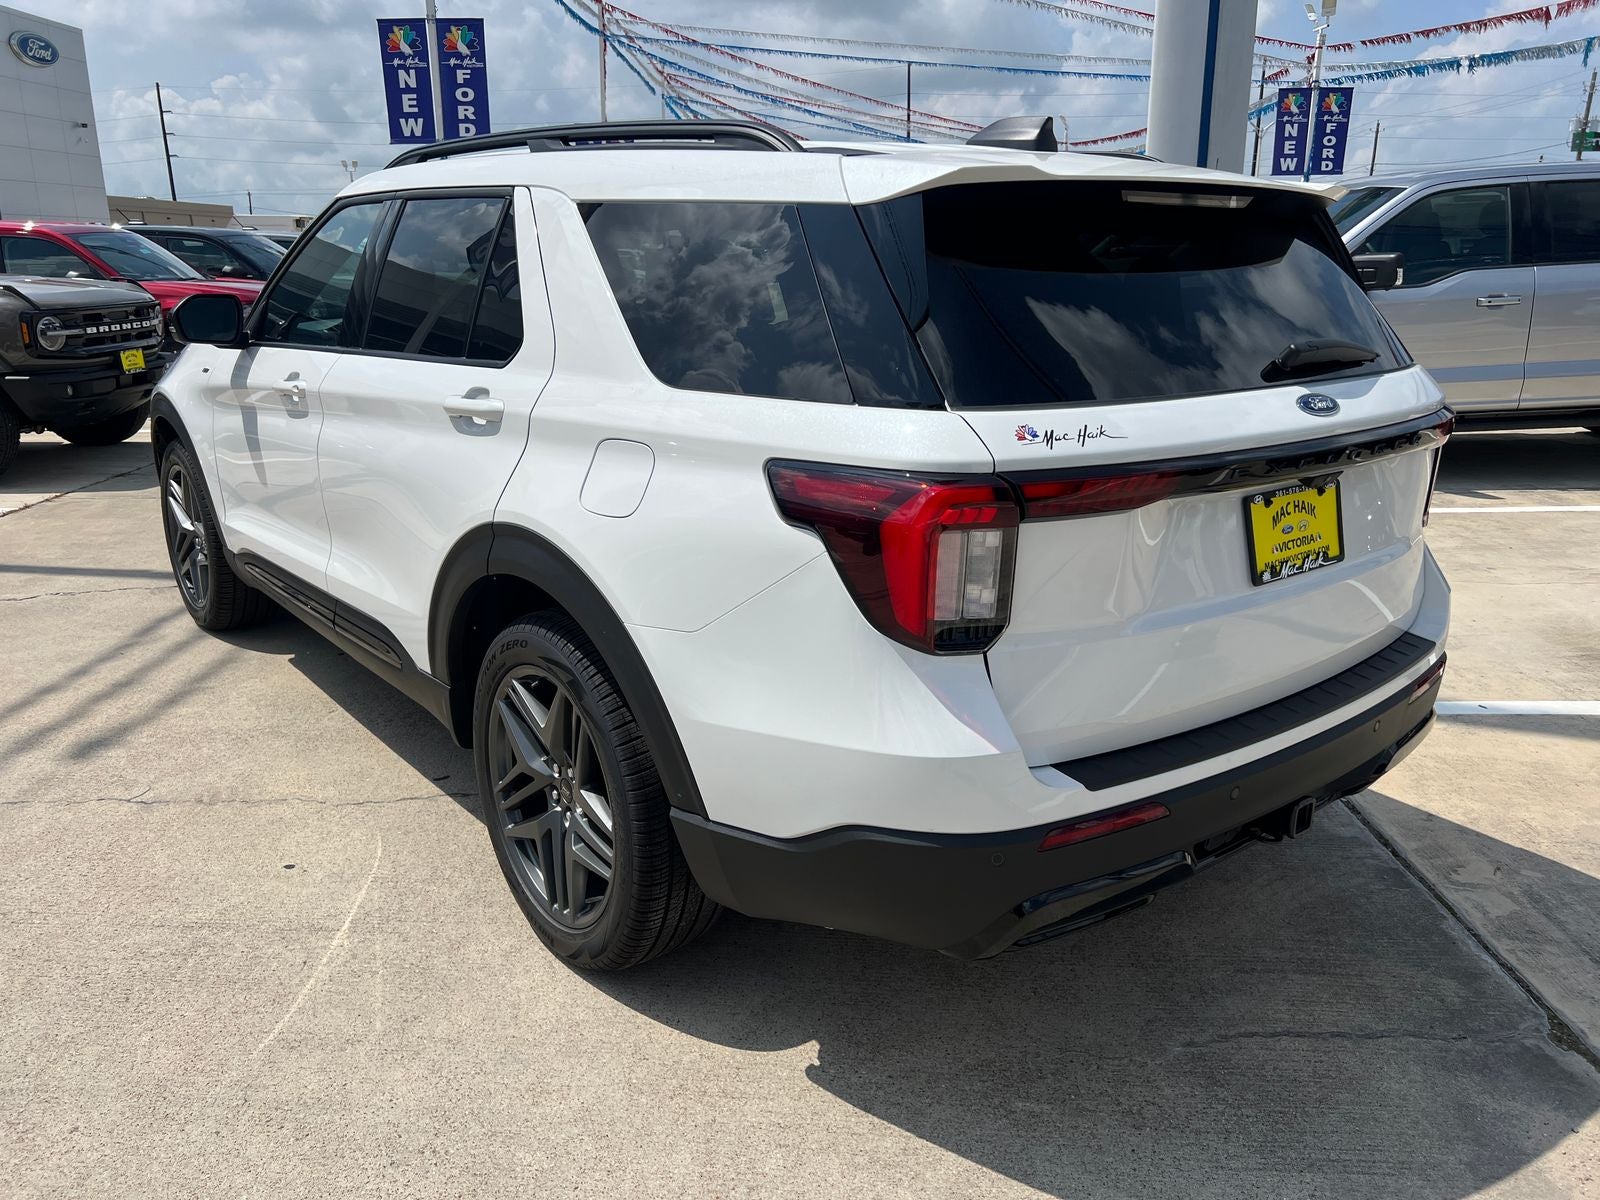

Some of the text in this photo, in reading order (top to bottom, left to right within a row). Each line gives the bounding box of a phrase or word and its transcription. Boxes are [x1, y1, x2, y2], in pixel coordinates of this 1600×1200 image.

[27, 38, 52, 61] Ford
[397, 69, 424, 137] NEW
[455, 69, 477, 137] FORD
[1279, 123, 1299, 172] NEW
[1321, 123, 1338, 172] FORD
[85, 320, 151, 334] BRONCO
[1308, 396, 1334, 410] Ford
[1041, 424, 1128, 450] Mac Haik
[1272, 499, 1317, 531] MAC HAIK
[1278, 533, 1315, 553] VICTORIA
[1280, 551, 1338, 579] Mac Haik
[500, 639, 529, 655] ZERO
